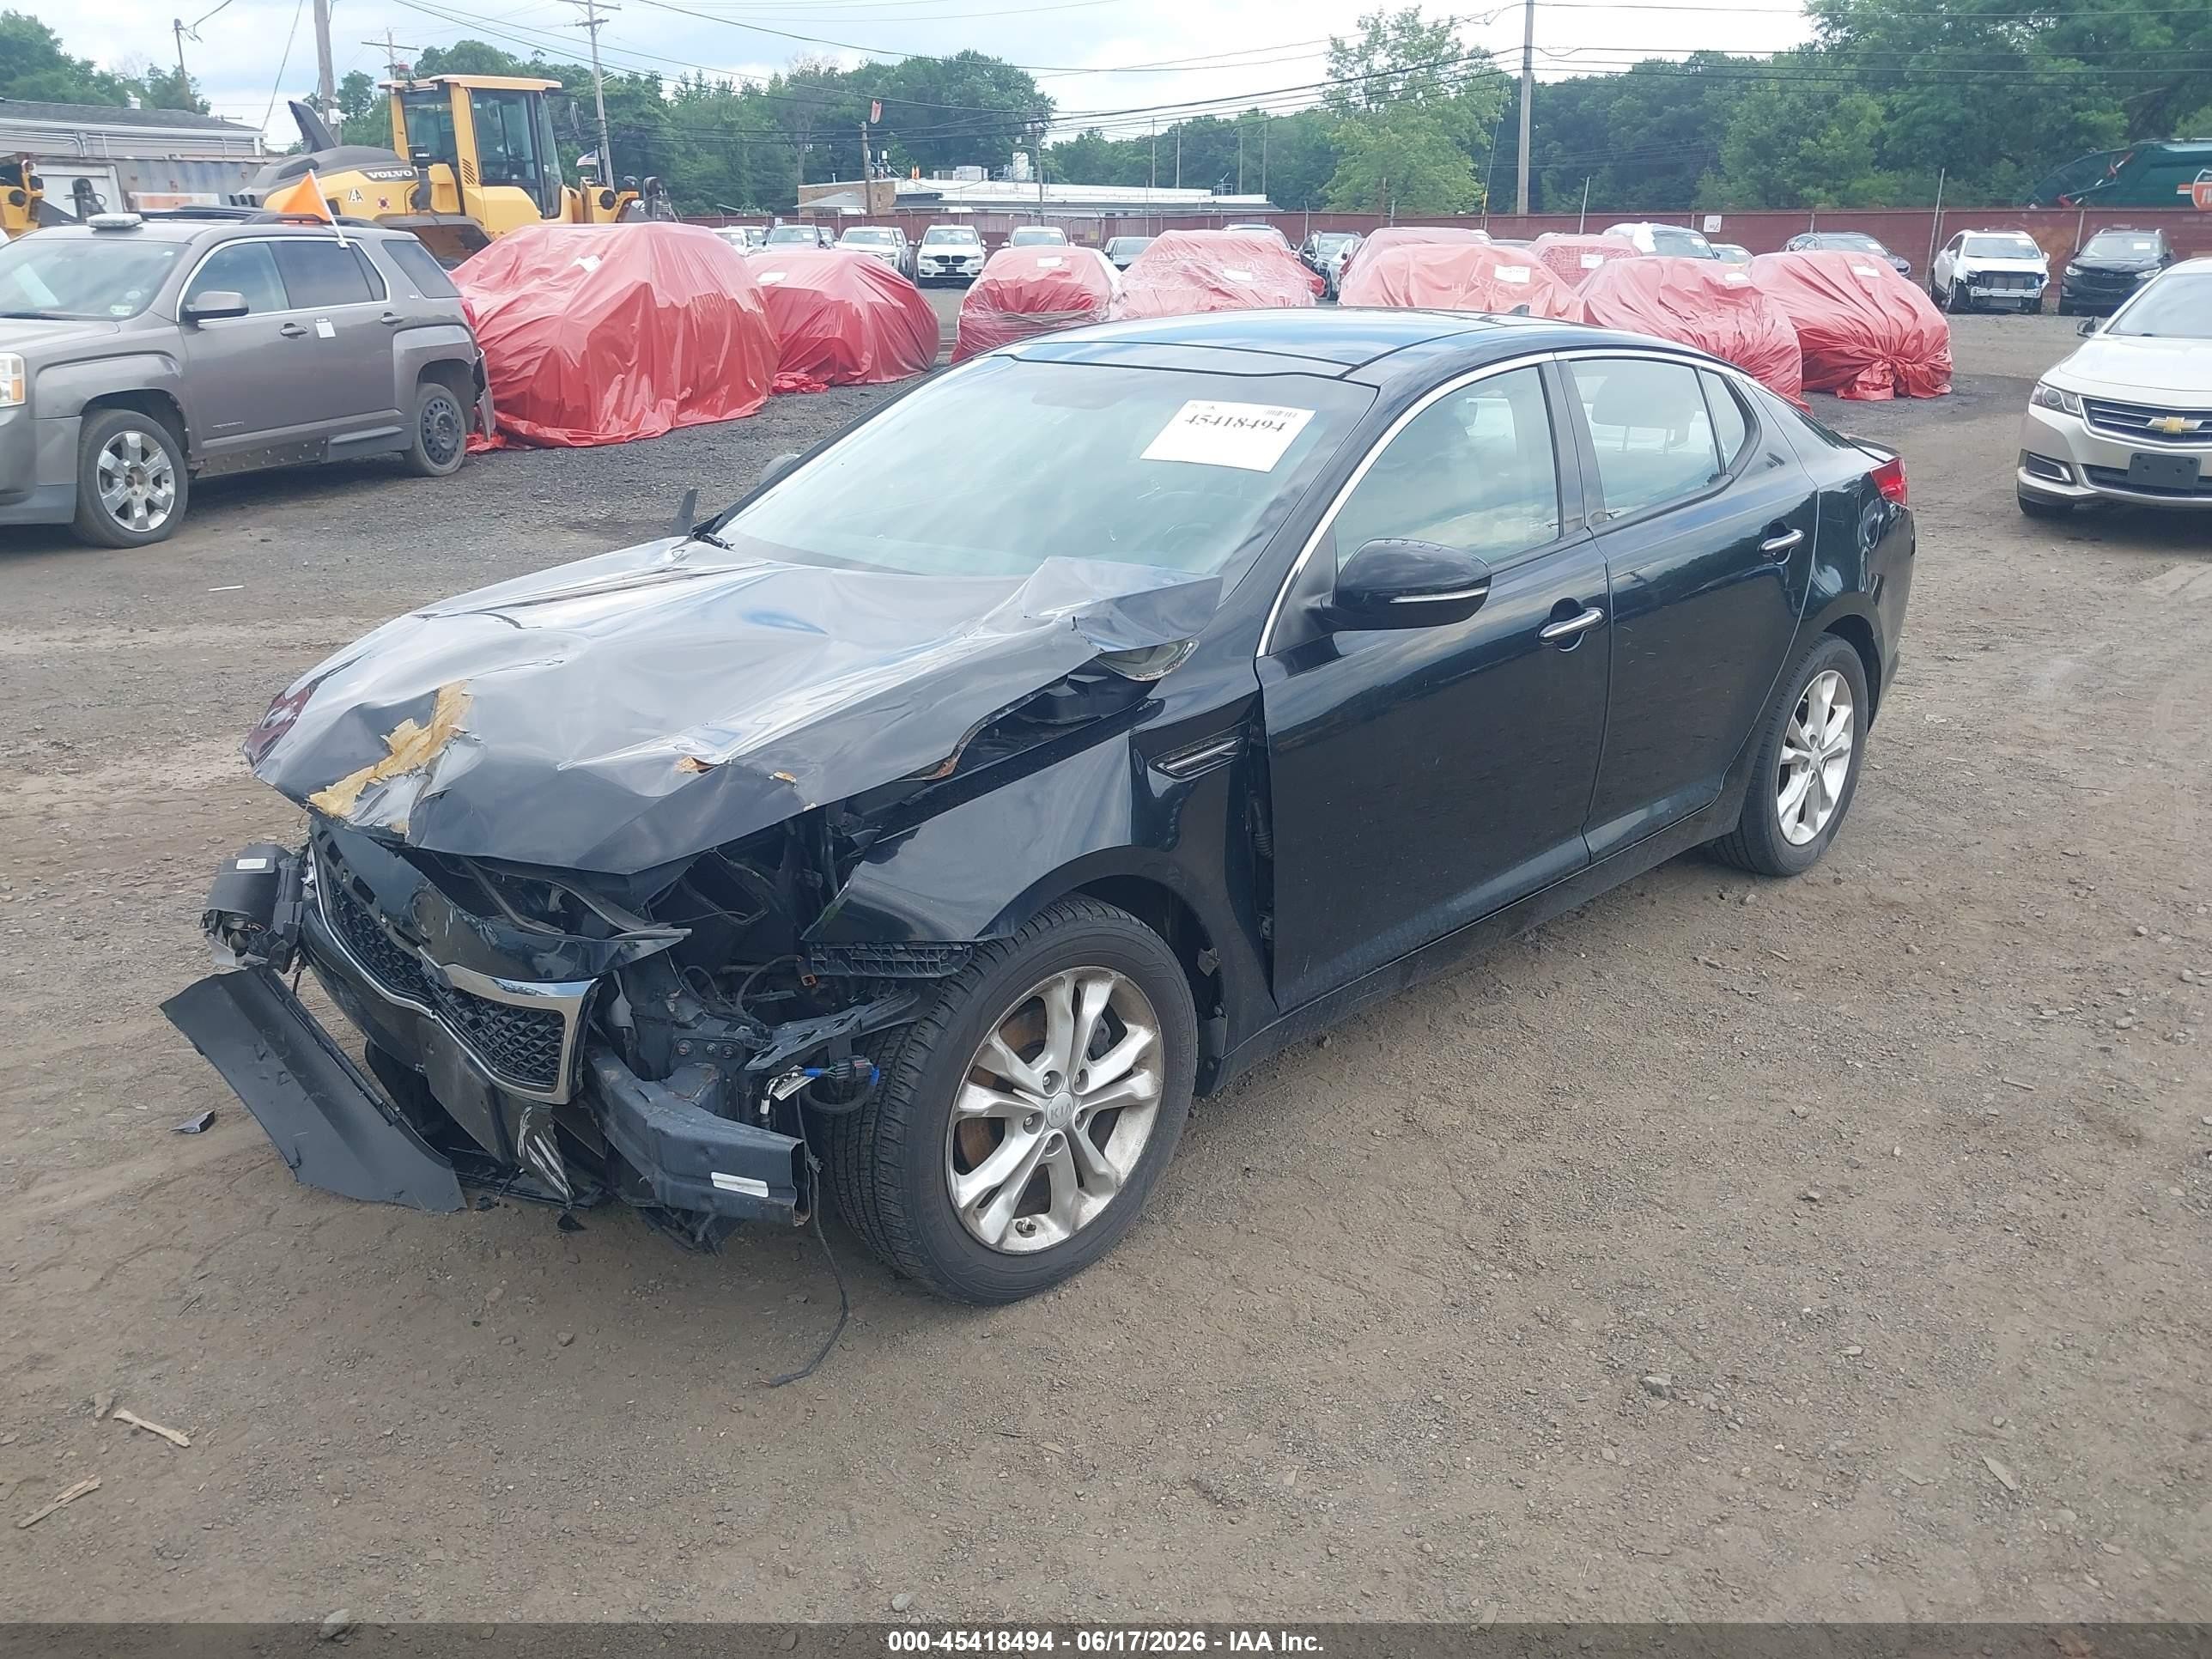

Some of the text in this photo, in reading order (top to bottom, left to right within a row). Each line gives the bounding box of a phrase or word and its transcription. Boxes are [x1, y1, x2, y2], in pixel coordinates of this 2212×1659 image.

[367, 169, 413, 179] VOLVO
[1184, 413, 1287, 432] 45418494
[1050, 1102, 1072, 1121] KIA
